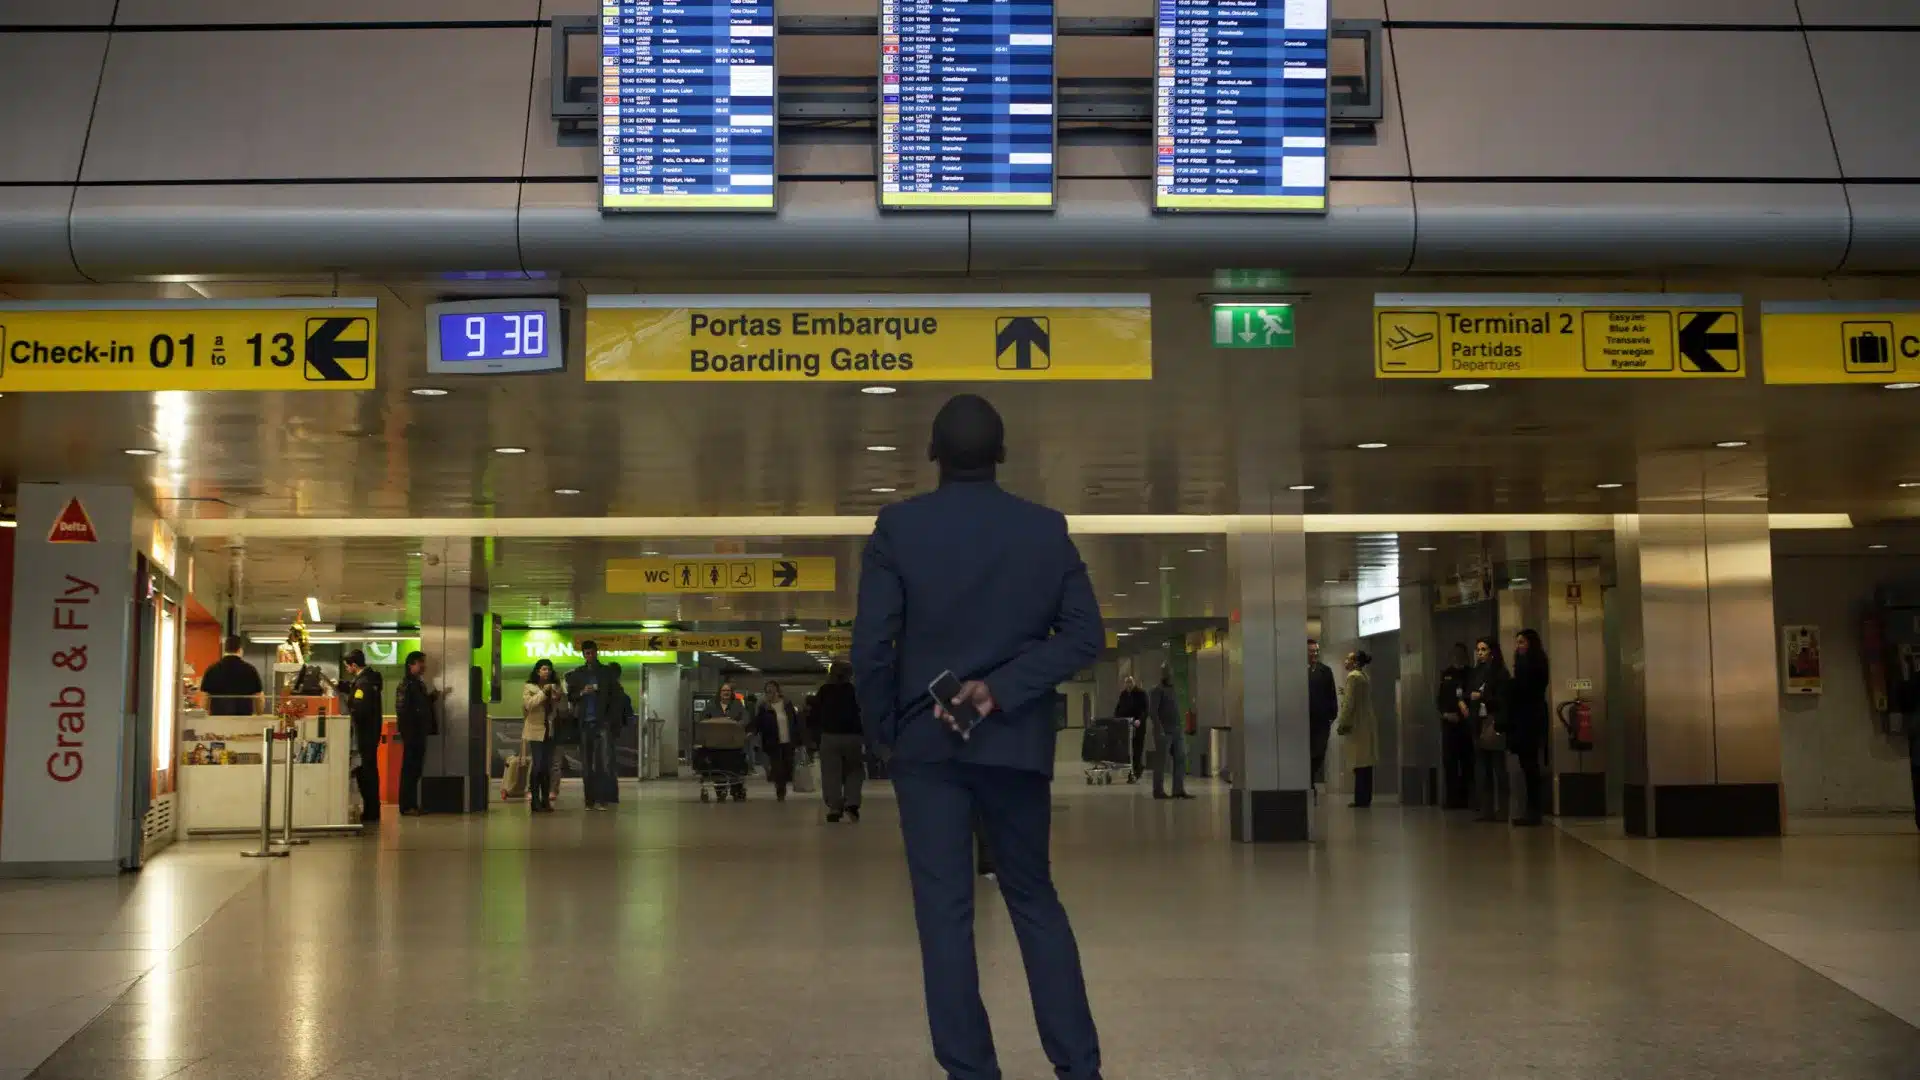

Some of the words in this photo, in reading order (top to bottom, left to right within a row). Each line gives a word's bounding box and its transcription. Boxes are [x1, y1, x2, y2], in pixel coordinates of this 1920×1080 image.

[690, 313, 783, 337] Portas
[792, 313, 937, 341] Embarque
[1445, 312, 1550, 335] Terminal
[1559, 312, 1573, 335] 2
[1609, 324, 1630, 333] Blue
[1631, 324, 1647, 333] Air
[465, 316, 485, 357] 9
[502, 313, 543, 356] 38
[1606, 336, 1651, 345] Transavia
[10, 340, 134, 365] Check-in
[149, 333, 195, 368] 01
[214, 335, 224, 346] a
[245, 332, 295, 368] 13
[1451, 342, 1522, 357] Partidas
[1603, 348, 1655, 358] Norwegian
[211, 353, 226, 367] to
[690, 348, 821, 378] Boarding
[831, 347, 914, 372] Gates
[1451, 359, 1521, 372] Departures
[1611, 359, 1647, 369] Ryanair
[59, 521, 88, 532] Delta
[644, 569, 670, 583] WC
[52, 573, 100, 630] Fly
[51, 645, 88, 672] &
[46, 686, 87, 783] Grab
